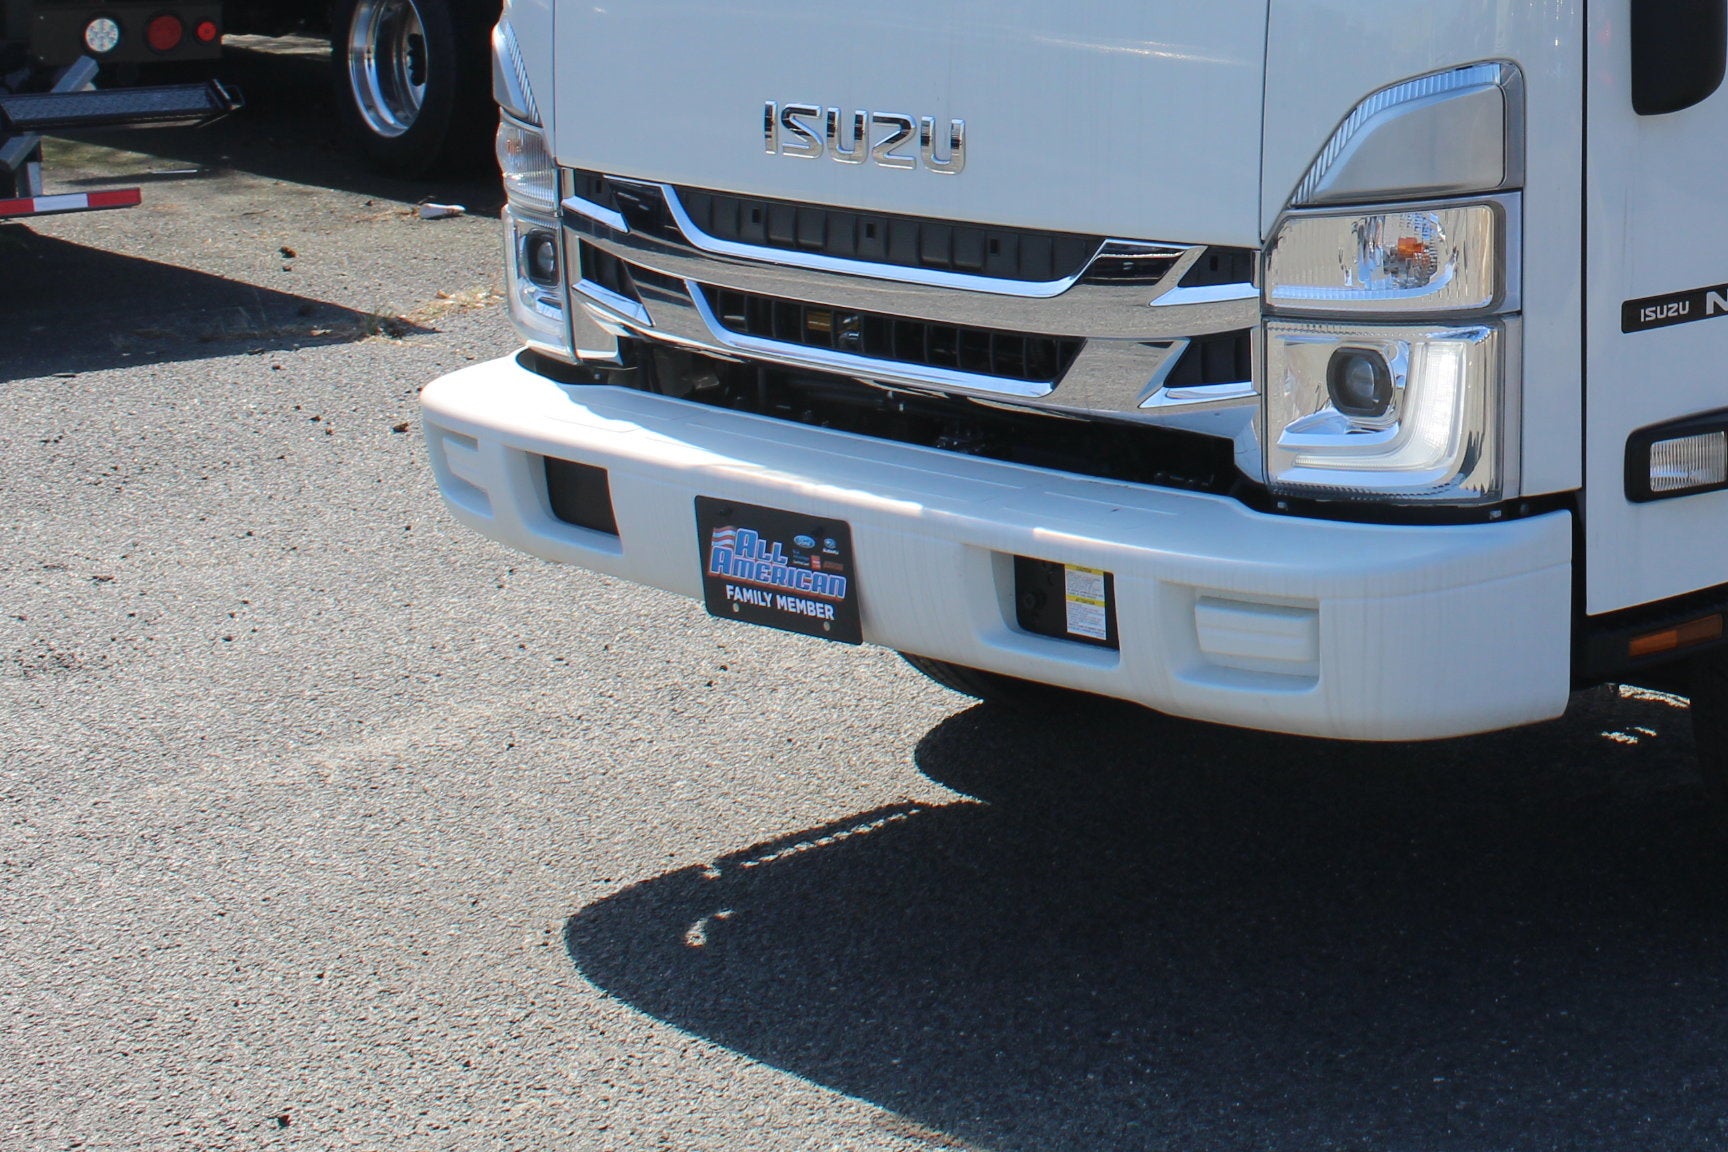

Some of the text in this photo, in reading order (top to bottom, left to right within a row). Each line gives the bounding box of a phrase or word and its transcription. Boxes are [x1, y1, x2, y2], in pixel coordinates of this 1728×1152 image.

[764, 100, 966, 175] ISUZU
[1640, 300, 1690, 323] ISUZU
[709, 546, 847, 599] AMERICAN
[726, 584, 835, 621] FAMILY MEMBER
